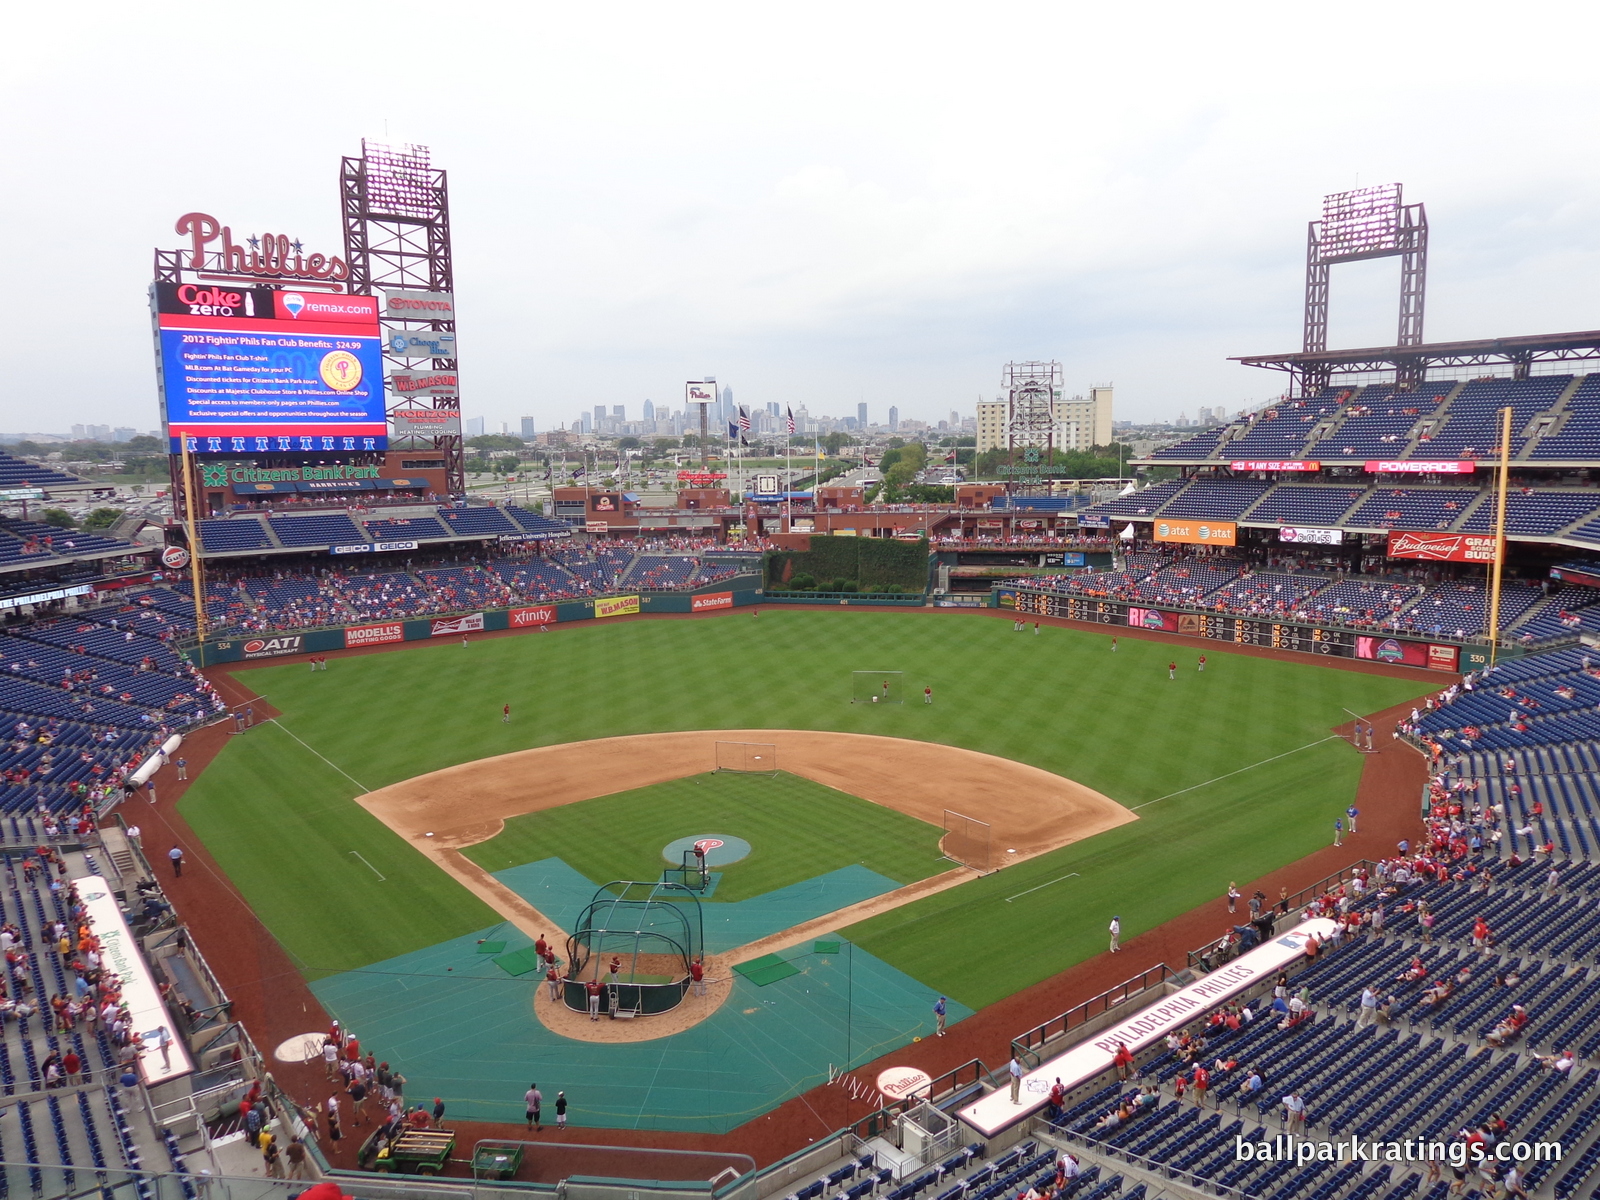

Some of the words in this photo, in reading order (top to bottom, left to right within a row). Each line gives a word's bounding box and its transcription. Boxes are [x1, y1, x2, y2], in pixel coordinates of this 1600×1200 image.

[175, 212, 349, 280] Phillies
[178, 284, 241, 308] Coke
[190, 305, 232, 316] zero
[307, 302, 372, 314] remax.com
[404, 299, 451, 311] TOYOTA
[182, 335, 205, 343] 2012
[206, 335, 239, 345] Fightin'
[240, 337, 260, 345] Phils
[261, 338, 276, 346] Fan
[298, 340, 333, 348] Benefits:
[336, 341, 361, 349] $24.99
[394, 410, 459, 418] HORIZON
[996, 465, 1038, 475] Citizens
[1040, 464, 1066, 474] Bank
[1379, 462, 1458, 471] POWERADE
[231, 468, 299, 483] Citizens
[302, 466, 344, 481] Bank
[345, 464, 380, 479] Park
[1019, 475, 1042, 485] Park
[1171, 527, 1190, 536] at&t
[1212, 529, 1231, 538] at&t
[1298, 533, 1332, 544] 6:01:59
[1391, 538, 1459, 551] Budweiser
[335, 544, 370, 553] GEICO
[380, 542, 413, 550] GEICO
[514, 609, 551, 624] xfinity
[348, 625, 401, 639] MODELL'S
[217, 642, 231, 650] 334
[263, 636, 301, 650] ATI
[348, 637, 379, 645] SPORTING
[1358, 636, 1373, 659] K
[245, 650, 272, 658] PHYSICAL
[1470, 654, 1484, 663] 330
[694, 839, 724, 855] P
[106, 939, 122, 959] Citizens
[114, 958, 132, 973] Bank
[119, 971, 137, 985] Park
[1094, 996, 1201, 1054] PHILADELPHIA
[1192, 964, 1255, 998] PHILLIES
[883, 1073, 925, 1093] Phillies
